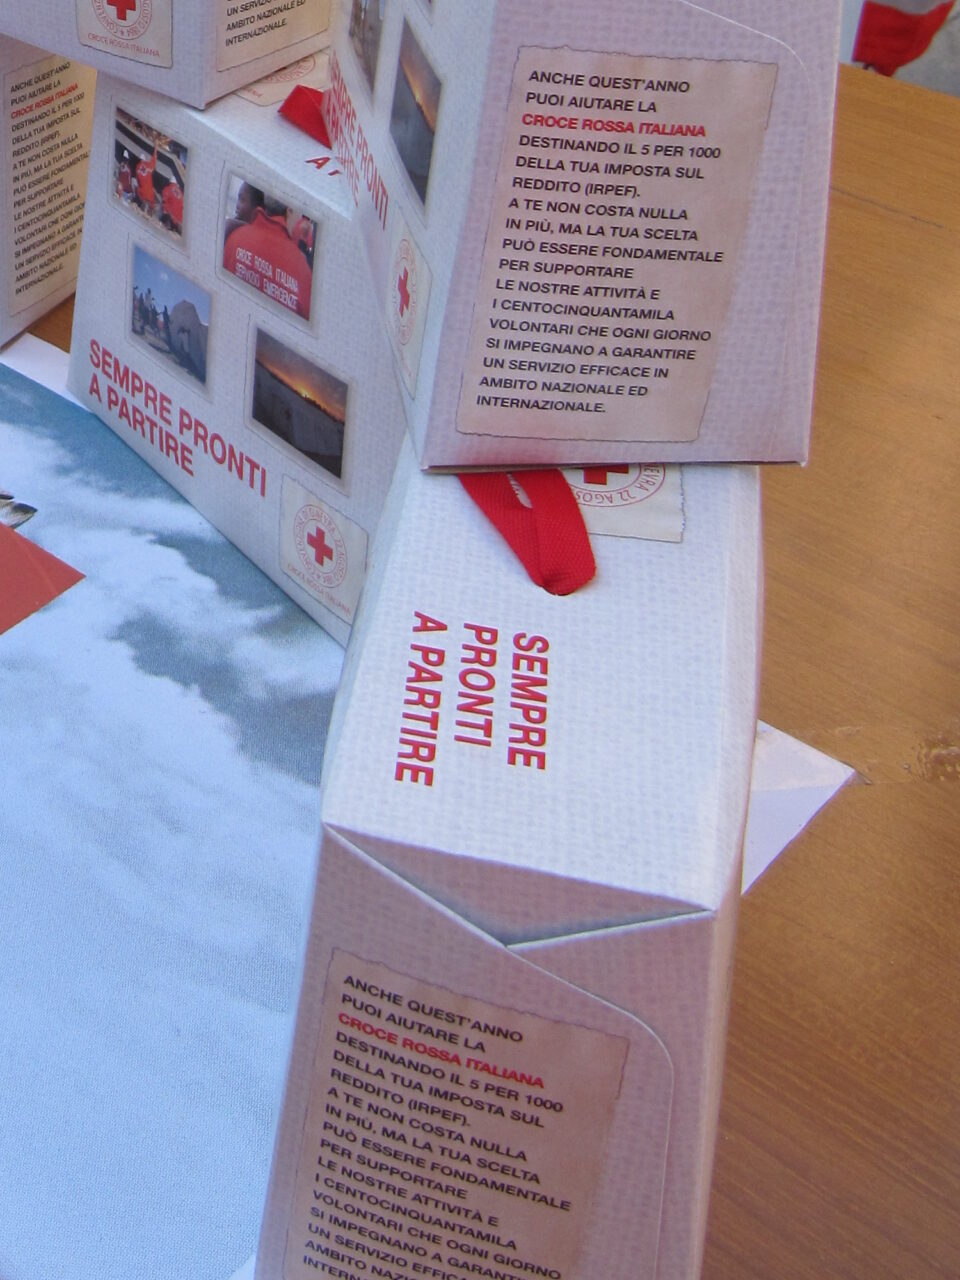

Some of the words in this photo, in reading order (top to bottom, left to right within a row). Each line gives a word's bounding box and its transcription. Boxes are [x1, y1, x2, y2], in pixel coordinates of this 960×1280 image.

[529, 71, 585, 86] ANCHE
[588, 76, 690, 93] QUEST'ANNO
[526, 92, 564, 106] PUOI
[568, 96, 634, 111] AIUTARE
[638, 101, 657, 113] LA
[522, 113, 578, 129] CROCE
[582, 119, 634, 133] ROSSA
[639, 122, 705, 137] ITALIANA
[519, 135, 620, 154] DESTINANDO
[624, 143, 637, 155] IL
[641, 144, 650, 155] 5
[653, 145, 684, 157] PER
[689, 147, 721, 158] 1000
[356, 123, 390, 231] PRONTI
[515, 156, 565, 171] DELLA
[570, 161, 600, 173] TUA
[604, 163, 671, 177] IMPOSTA
[675, 167, 704, 179] SUL
[512, 177, 581, 193] REDDITO
[585, 183, 640, 199] (IRPEF).
[508, 198, 519, 208] A
[524, 199, 543, 211] TE
[546, 201, 581, 214] NON
[584, 204, 634, 217] COSTA
[639, 207, 688, 220] NULLA
[506, 218, 521, 229] IN
[525, 219, 554, 234] PIÙ,
[558, 223, 582, 235] MA
[586, 225, 605, 236] LA
[610, 226, 639, 238] TUA
[643, 228, 698, 241] SCELTA
[502, 238, 535, 252] PUÒ
[539, 242, 599, 256] ESSERE
[602, 246, 723, 262] FONDAMENTALE
[499, 258, 529, 271] PER
[533, 262, 634, 279] SUPPORTARE
[496, 278, 515, 290] LE
[518, 281, 580, 296] NOSTRE
[583, 286, 646, 299] ATTIVITÀ
[650, 289, 660, 300] E
[492, 298, 497, 308] I
[501, 299, 674, 320] CENTOCINQUANTAMILA
[490, 318, 573, 335] VOLONTARI
[577, 325, 609, 337] CHE
[612, 327, 649, 339] OGNI
[653, 329, 711, 341] GIORNO
[486, 338, 500, 348] SI
[504, 339, 594, 356] IMPEGNANO
[598, 347, 608, 356] A
[612, 347, 696, 360] GARANTIRE
[483, 357, 505, 368] UN
[508, 359, 576, 374] SERVIZIO
[579, 364, 650, 378] EFFICACE
[654, 368, 669, 378] IN
[479, 377, 538, 391] AMBITO
[541, 382, 625, 395] NAZIONALE
[628, 386, 648, 396] ED
[477, 395, 605, 413] INTERNAZIONALE.
[90, 375, 101, 401] A
[108, 386, 192, 476] PARTIRE
[91, 340, 171, 425] SEMPRE
[180, 409, 266, 496] PRONTI
[414, 613, 447, 632] A
[456, 624, 498, 747] PRONTI
[509, 634, 549, 769] SEMPRE
[396, 645, 445, 786] PARTIRE
[344, 975, 403, 1006] ANCHE
[407, 1000, 523, 1042] QUEST'ANNO
[341, 993, 382, 1019] PUOI
[385, 1013, 459, 1045] AIUTARE
[464, 1038, 485, 1053] LA
